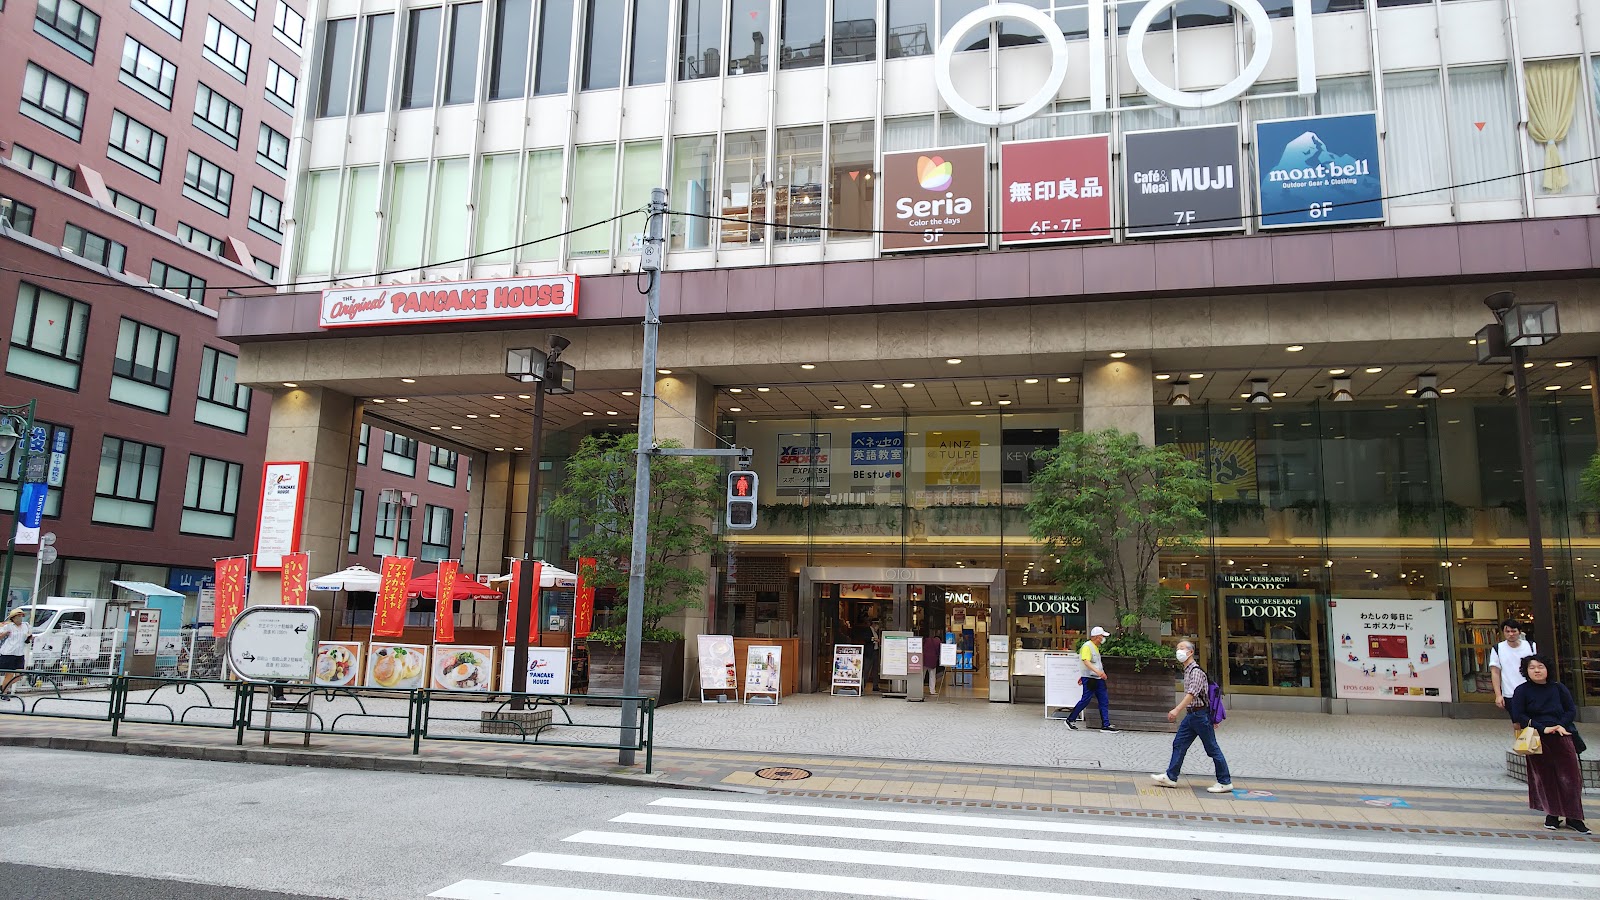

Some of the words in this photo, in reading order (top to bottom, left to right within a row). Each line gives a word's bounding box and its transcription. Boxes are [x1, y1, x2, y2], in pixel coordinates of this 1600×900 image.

[1133, 169, 1160, 184] Café
[1160, 169, 1169, 182] &
[1170, 164, 1234, 193] MUJI
[1331, 177, 1358, 186] Clothing
[1009, 176, 1103, 204] 無印良品
[1141, 181, 1170, 195] Meal
[896, 191, 972, 219] Seria
[909, 219, 929, 227] Color
[943, 217, 961, 226] days
[1173, 210, 1196, 227] 7F
[923, 227, 944, 243] 5F
[329, 290, 388, 320] Original
[390, 288, 489, 314] PANCAKE
[493, 283, 565, 309] HOUSE
[854, 436, 902, 448] ベネッセの
[940, 440, 971, 449] AINZ
[853, 449, 902, 461] 英語教室
[939, 450, 979, 460] TULPE
[853, 470, 865, 479] BE
[867, 469, 902, 479] studio
[37, 494, 45, 511] TOKYO
[389, 563, 401, 608] フォカッチャ
[381, 563, 394, 626] フレンチトースト
[944, 592, 975, 604] FANCL
[1028, 601, 1080, 613] DOORS
[1241, 605, 1297, 618] DOORS
[1363, 622, 1414, 631] エポスカード。
